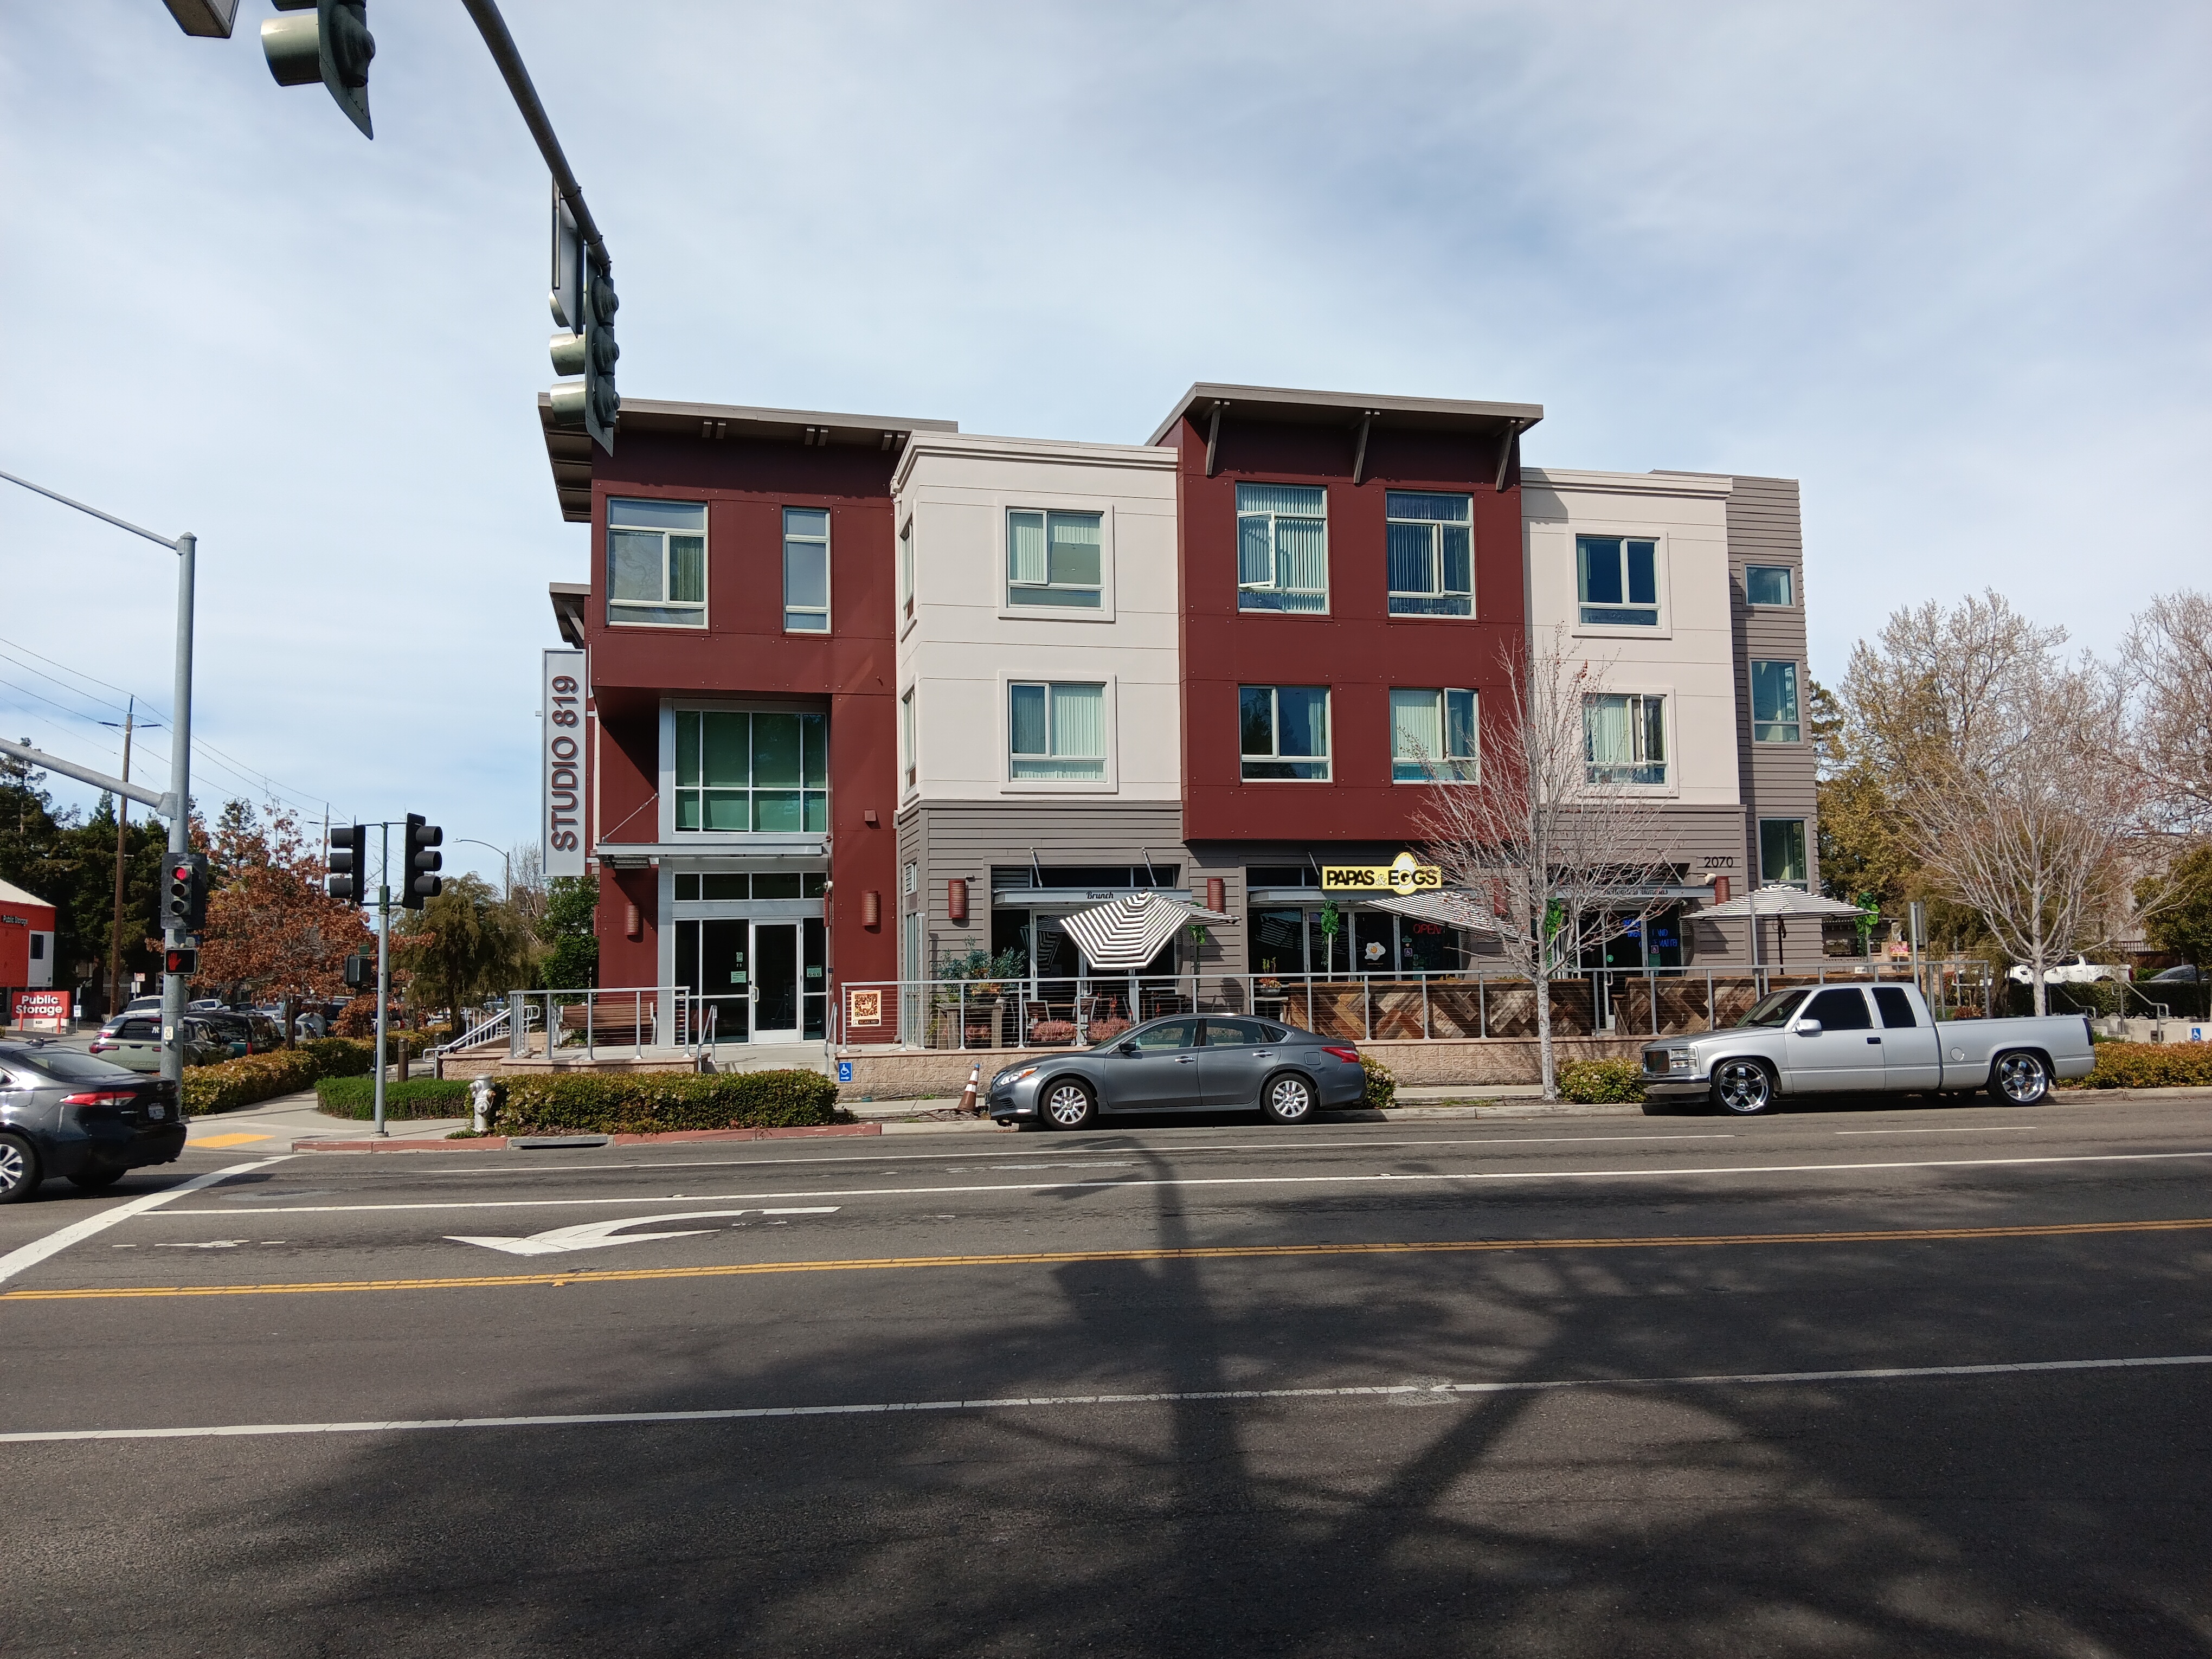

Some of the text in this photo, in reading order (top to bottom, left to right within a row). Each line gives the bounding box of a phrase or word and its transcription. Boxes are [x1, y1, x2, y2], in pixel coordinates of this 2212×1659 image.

[551, 675, 576, 850] STUDIO 819
[1704, 856, 1733, 868] 2070
[1327, 869, 1437, 886] PAPAS & EGGS
[1086, 891, 1114, 899] Brunch
[1413, 923, 1442, 934] OPEN
[22, 995, 59, 1004] Public
[16, 1005, 63, 1016] Storage
